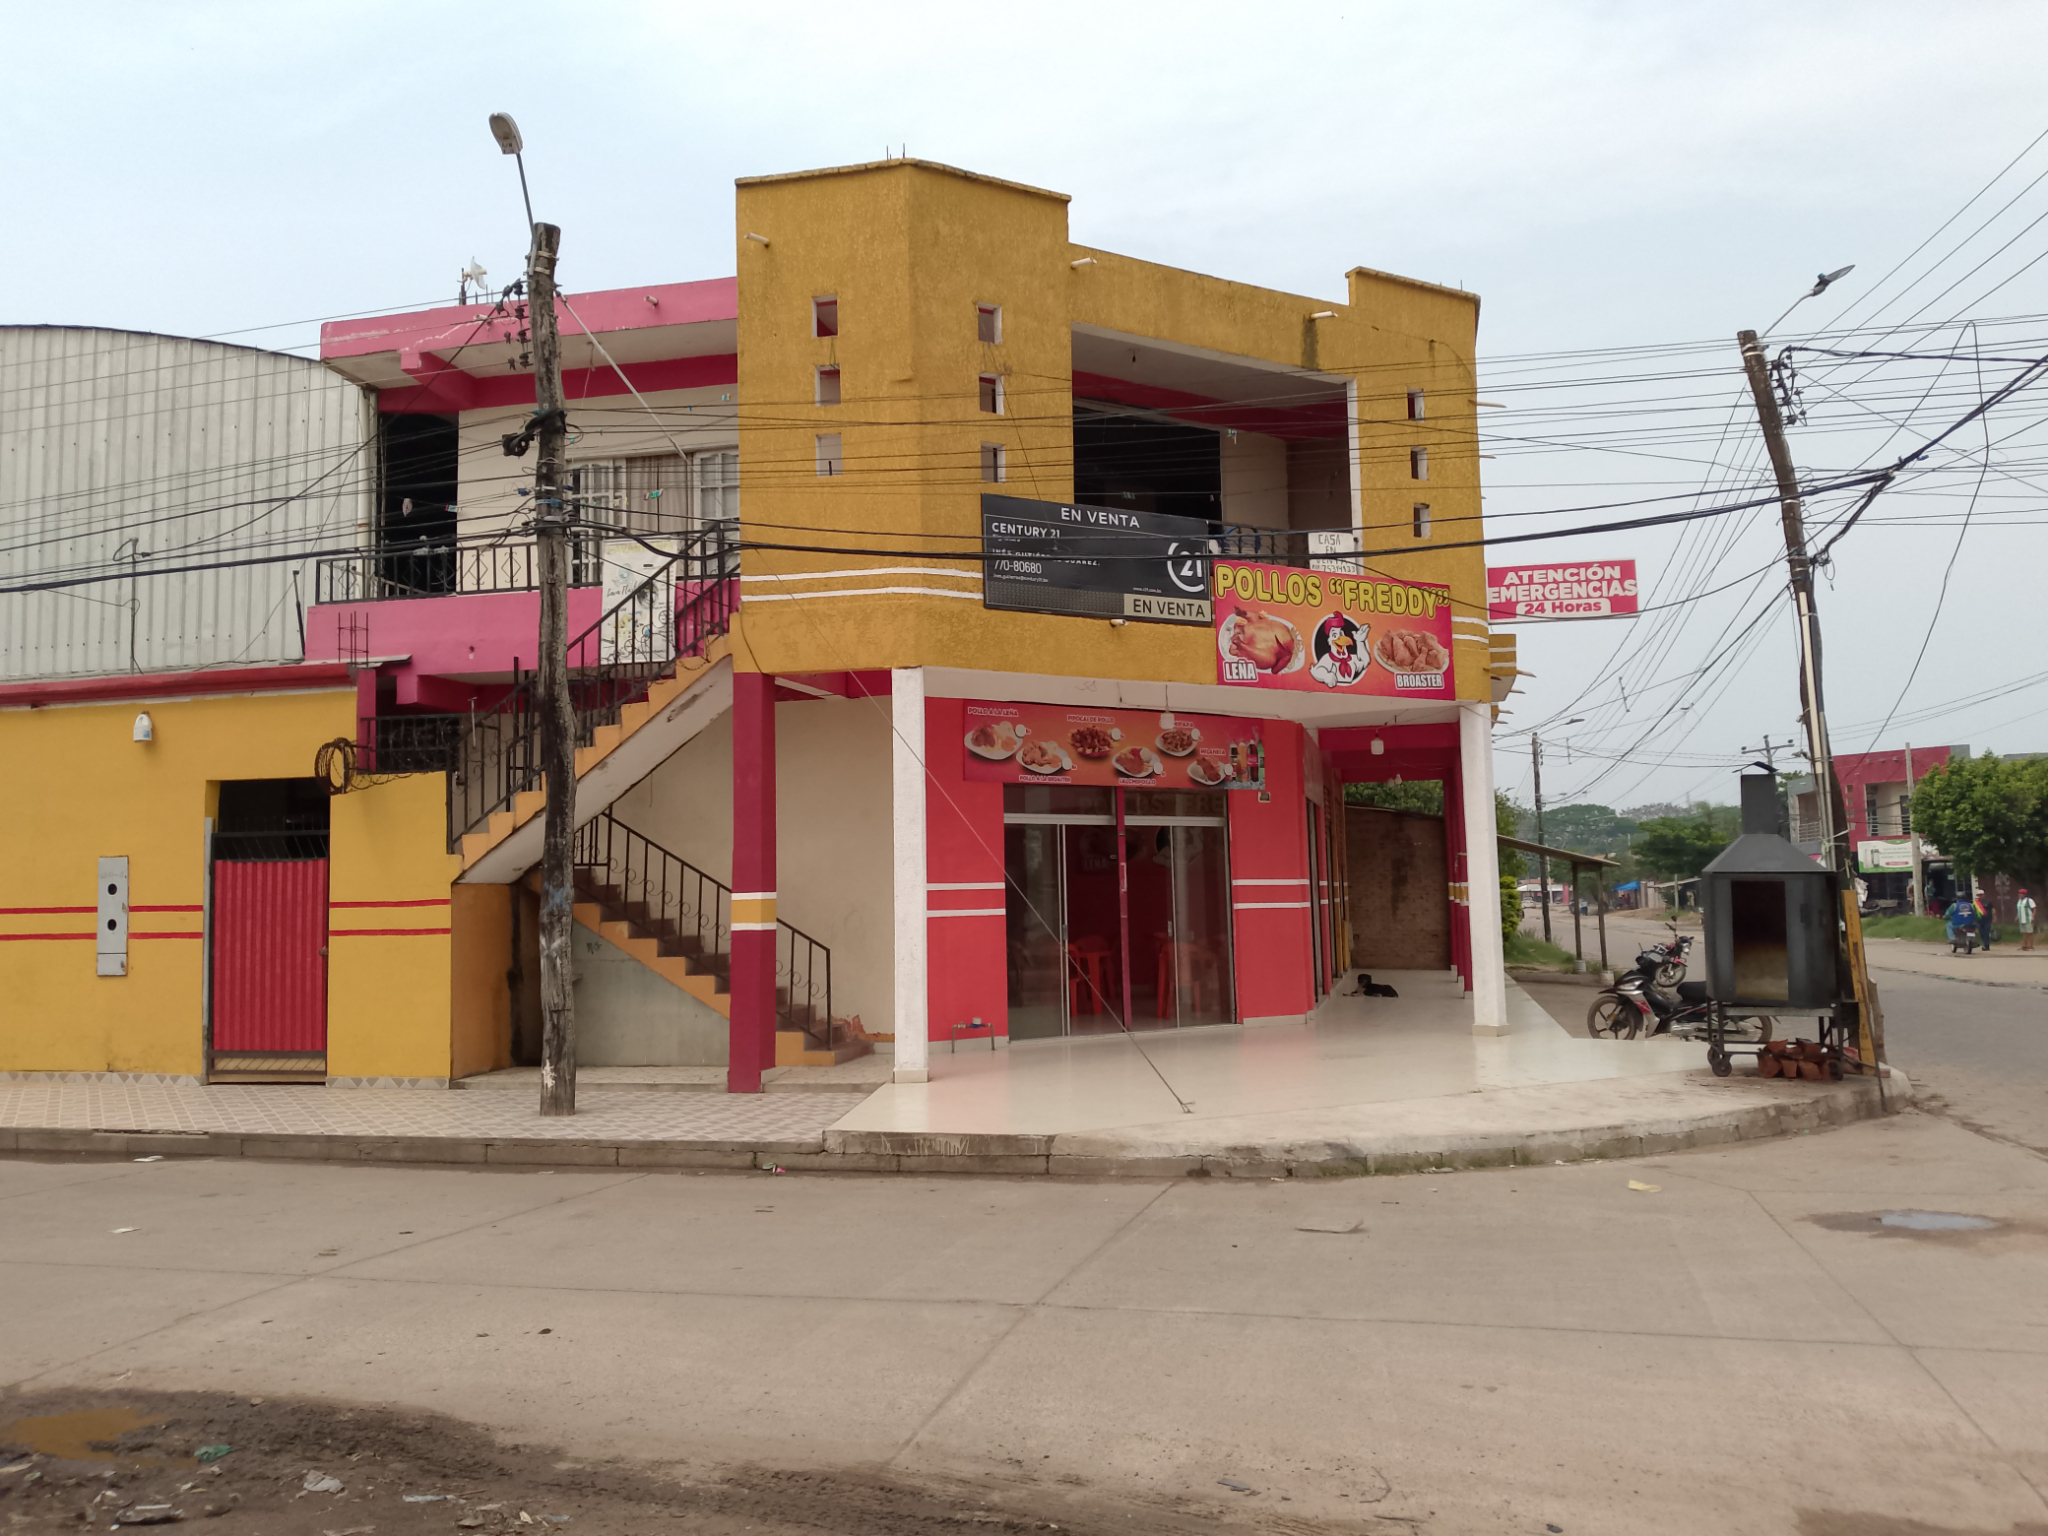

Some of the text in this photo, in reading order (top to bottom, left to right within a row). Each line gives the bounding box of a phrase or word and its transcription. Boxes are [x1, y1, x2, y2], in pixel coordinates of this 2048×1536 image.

[1061, 507, 1140, 528] EN VENTA
[992, 522, 1048, 538] CENTURY
[1050, 529, 1060, 538] 21
[1318, 534, 1341, 546] CASA
[1326, 546, 1336, 554] EN
[1503, 563, 1621, 586] ATENCIÓN
[1215, 564, 1450, 618] POLLOS "FREDDY"
[1488, 580, 1638, 603] EMERGENCIAS
[1133, 598, 1206, 618] EN VENTA
[1524, 601, 1602, 614] 24 Horas
[1225, 659, 1256, 680] LEÑA
[1396, 674, 1444, 688] BROASTER
[1002, 708, 1018, 717] LEÑA
